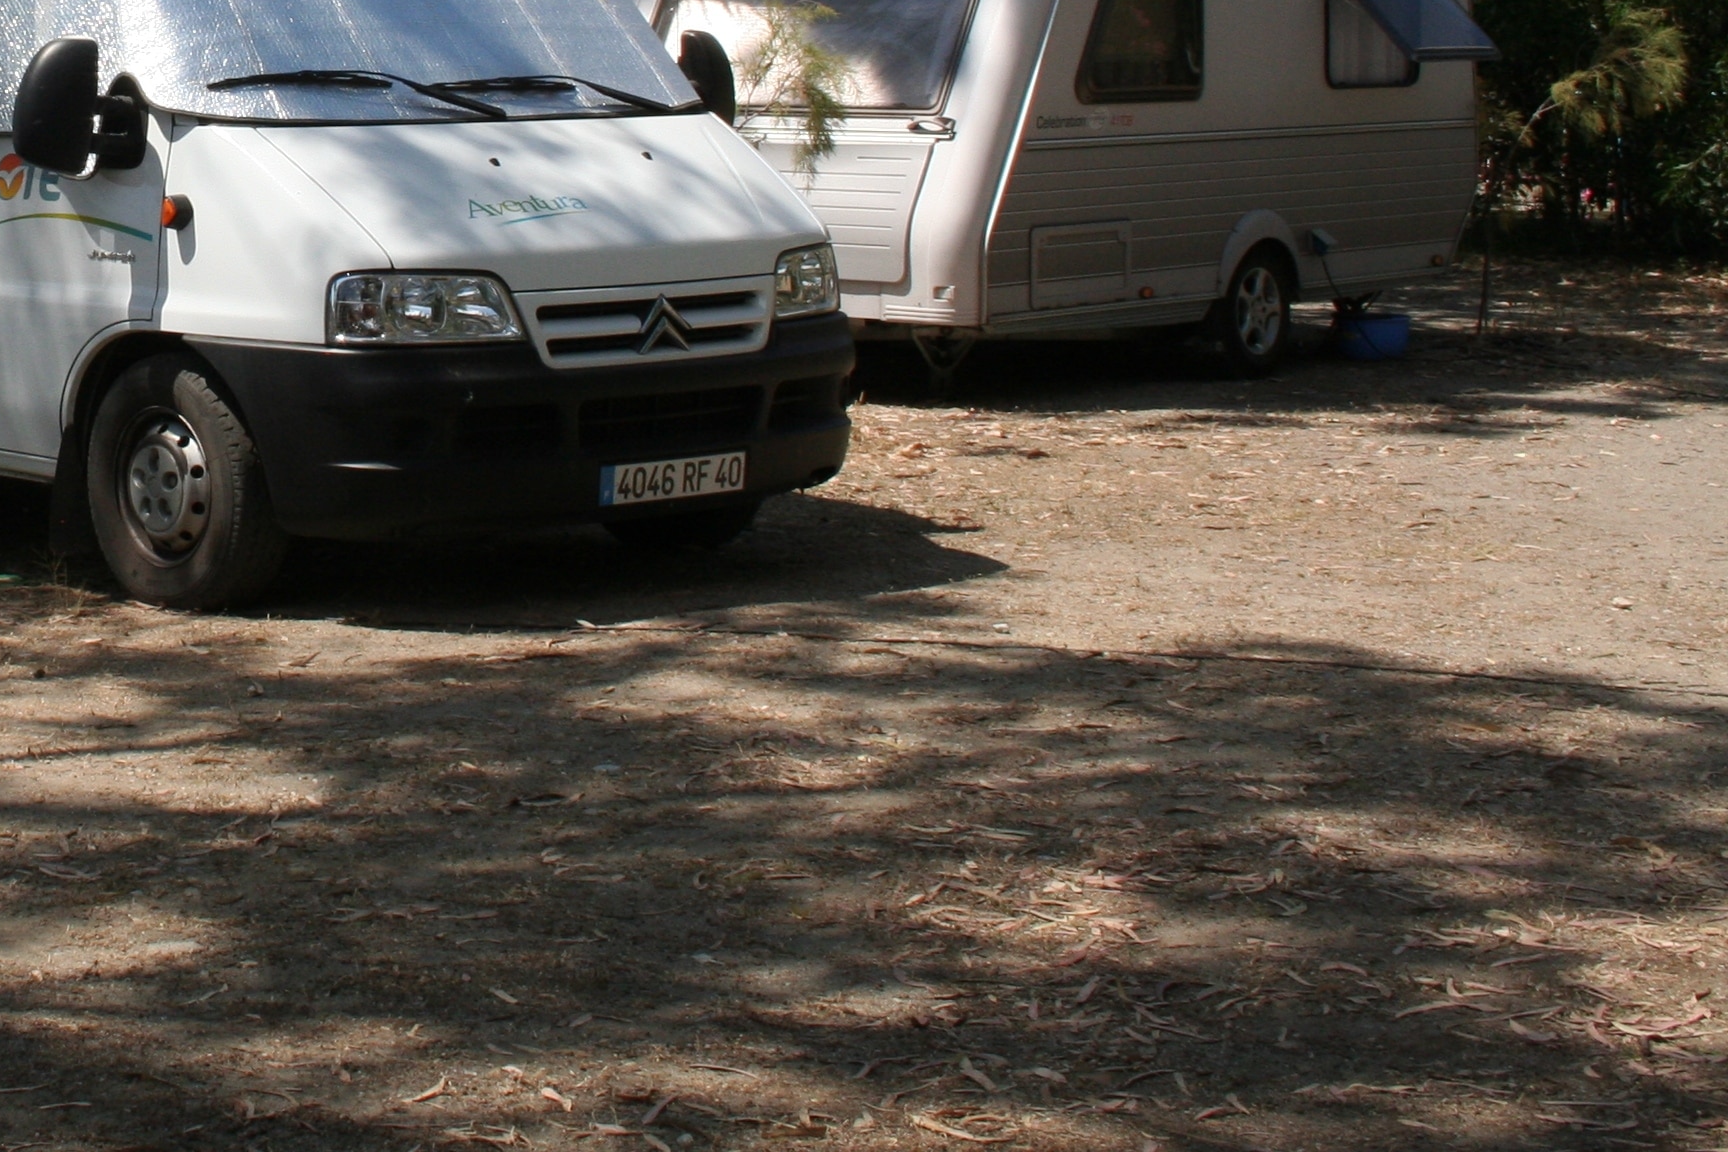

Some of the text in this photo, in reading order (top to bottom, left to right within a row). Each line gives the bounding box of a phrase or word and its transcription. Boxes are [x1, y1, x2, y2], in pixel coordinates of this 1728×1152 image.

[468, 195, 588, 220] Aventura
[617, 464, 676, 499] 4046
[682, 459, 711, 492] RF
[714, 456, 741, 488] 40
